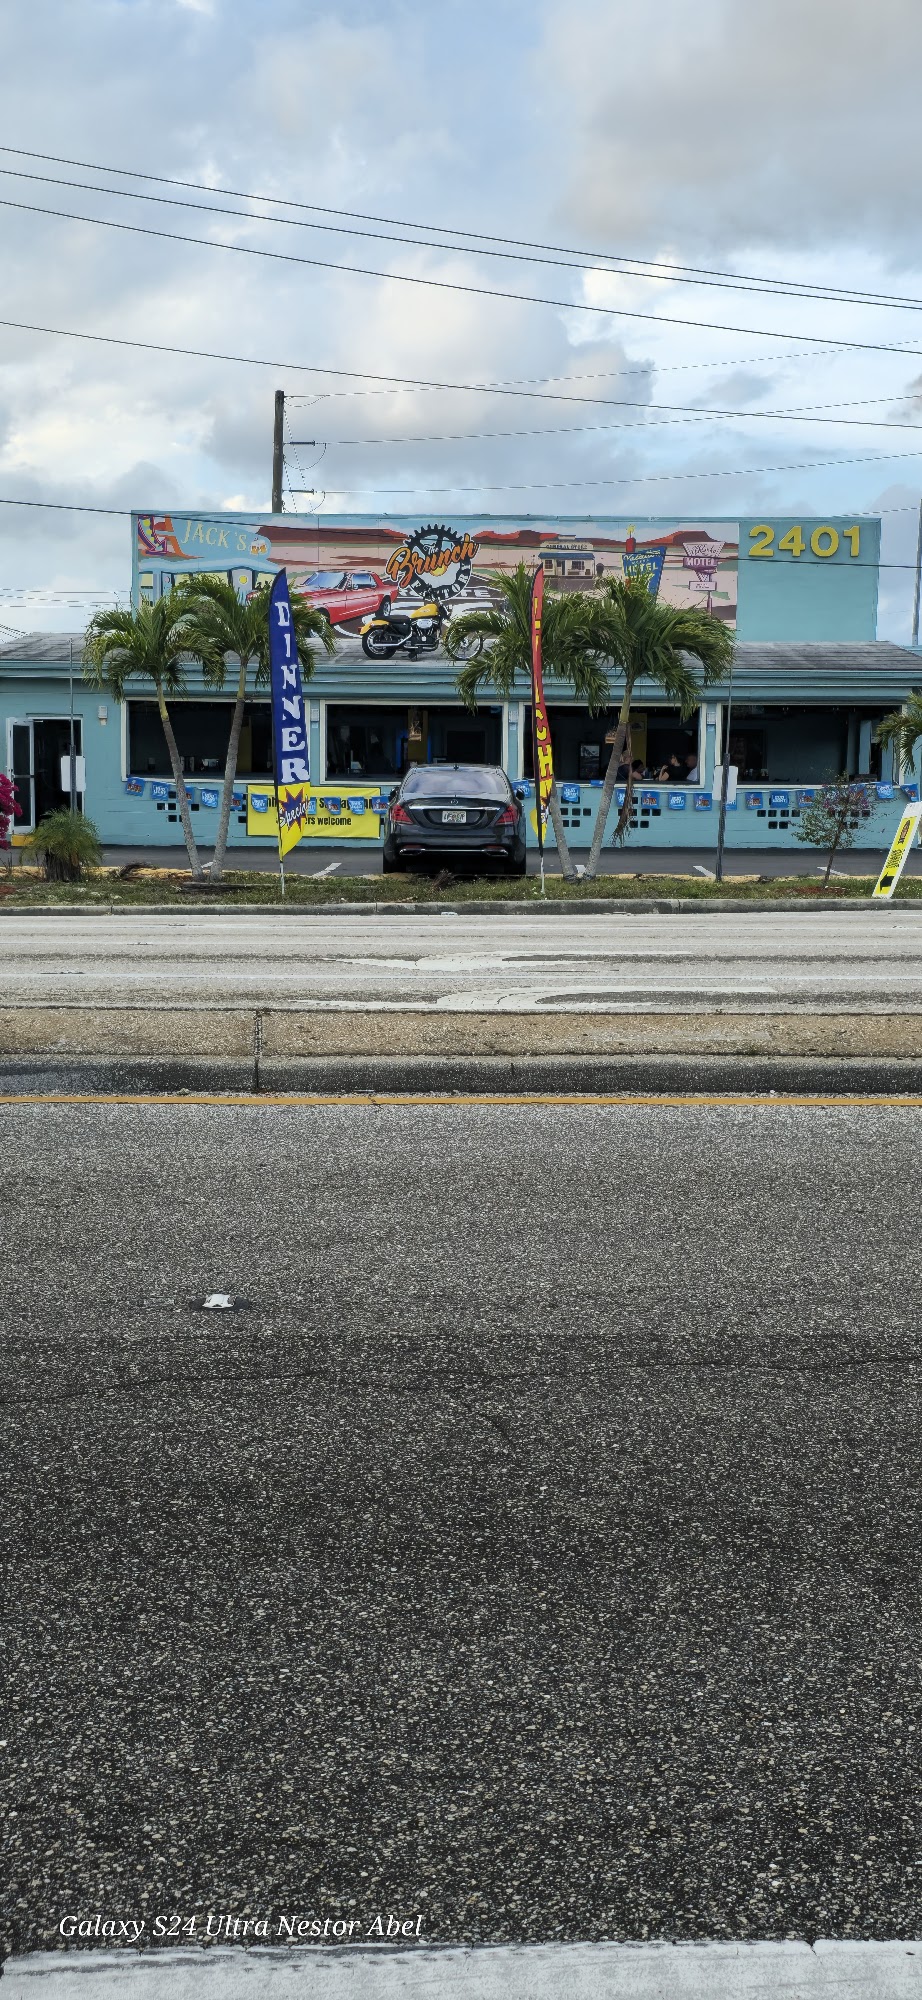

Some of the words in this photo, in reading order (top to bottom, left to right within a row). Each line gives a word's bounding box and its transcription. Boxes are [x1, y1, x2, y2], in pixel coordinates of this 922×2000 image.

[181, 519, 247, 551] JACK'S
[748, 524, 860, 557] 2401
[386, 532, 480, 589] Brunch
[686, 557, 717, 567] MOTEL
[275, 602, 310, 784] DINNER
[317, 817, 352, 826] welcome
